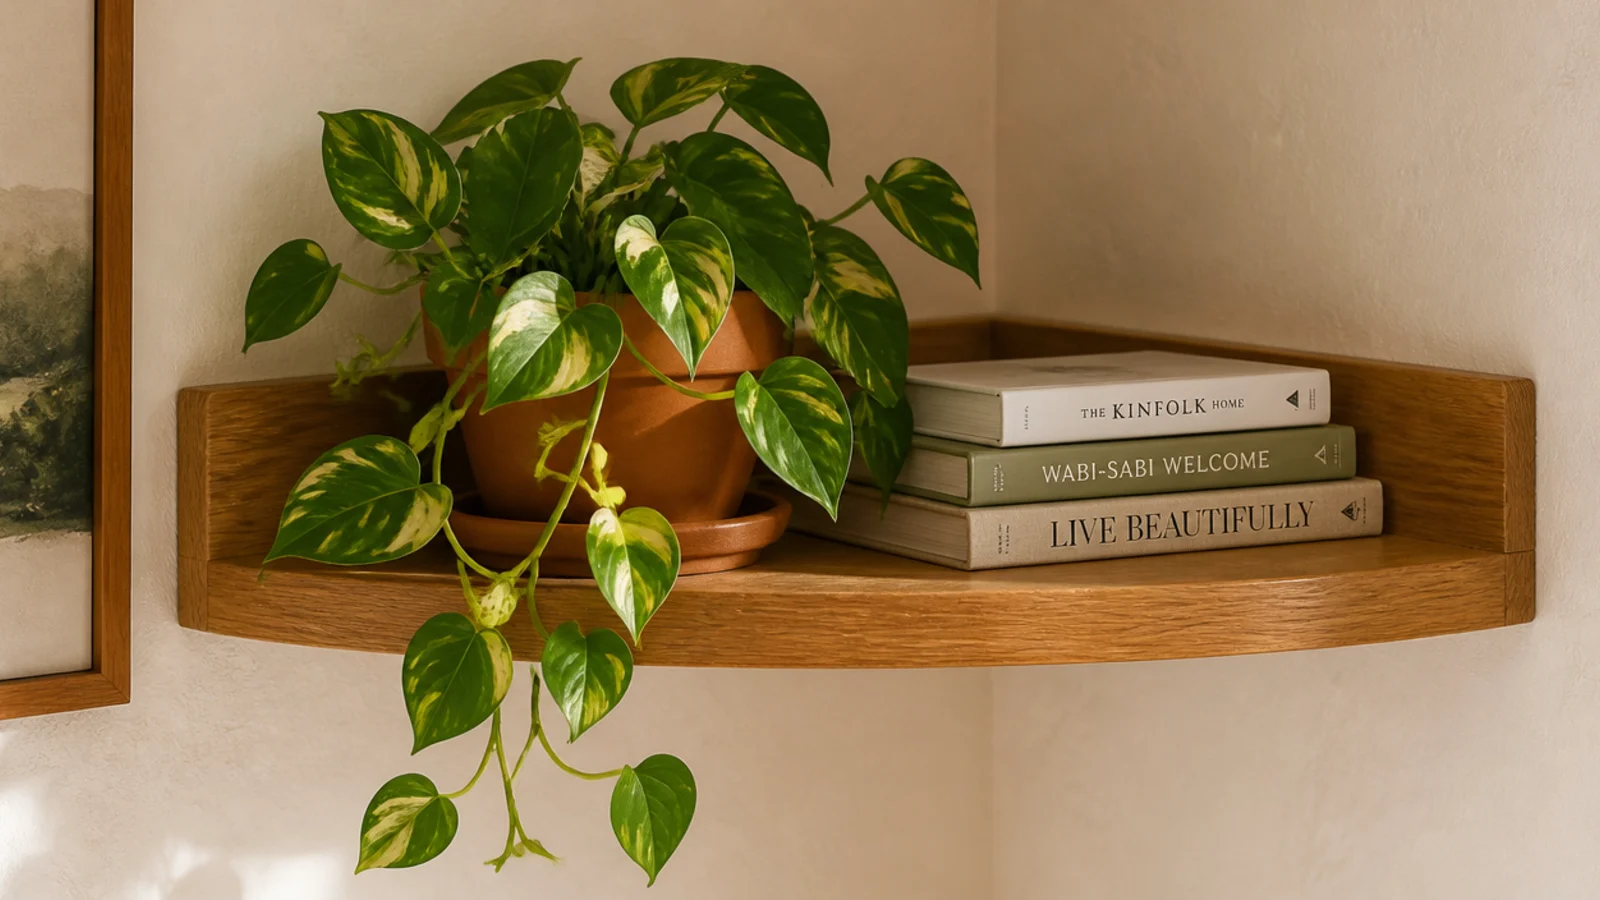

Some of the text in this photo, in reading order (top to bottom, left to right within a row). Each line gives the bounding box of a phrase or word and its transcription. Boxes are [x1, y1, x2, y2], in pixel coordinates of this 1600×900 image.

[1081, 398, 1245, 420] THE KINFOLK HOME
[1042, 450, 1270, 483] WABI-SABI WELCOME
[1050, 516, 1117, 548] LIVE
[1126, 500, 1314, 542] BEAUTIFULLY
